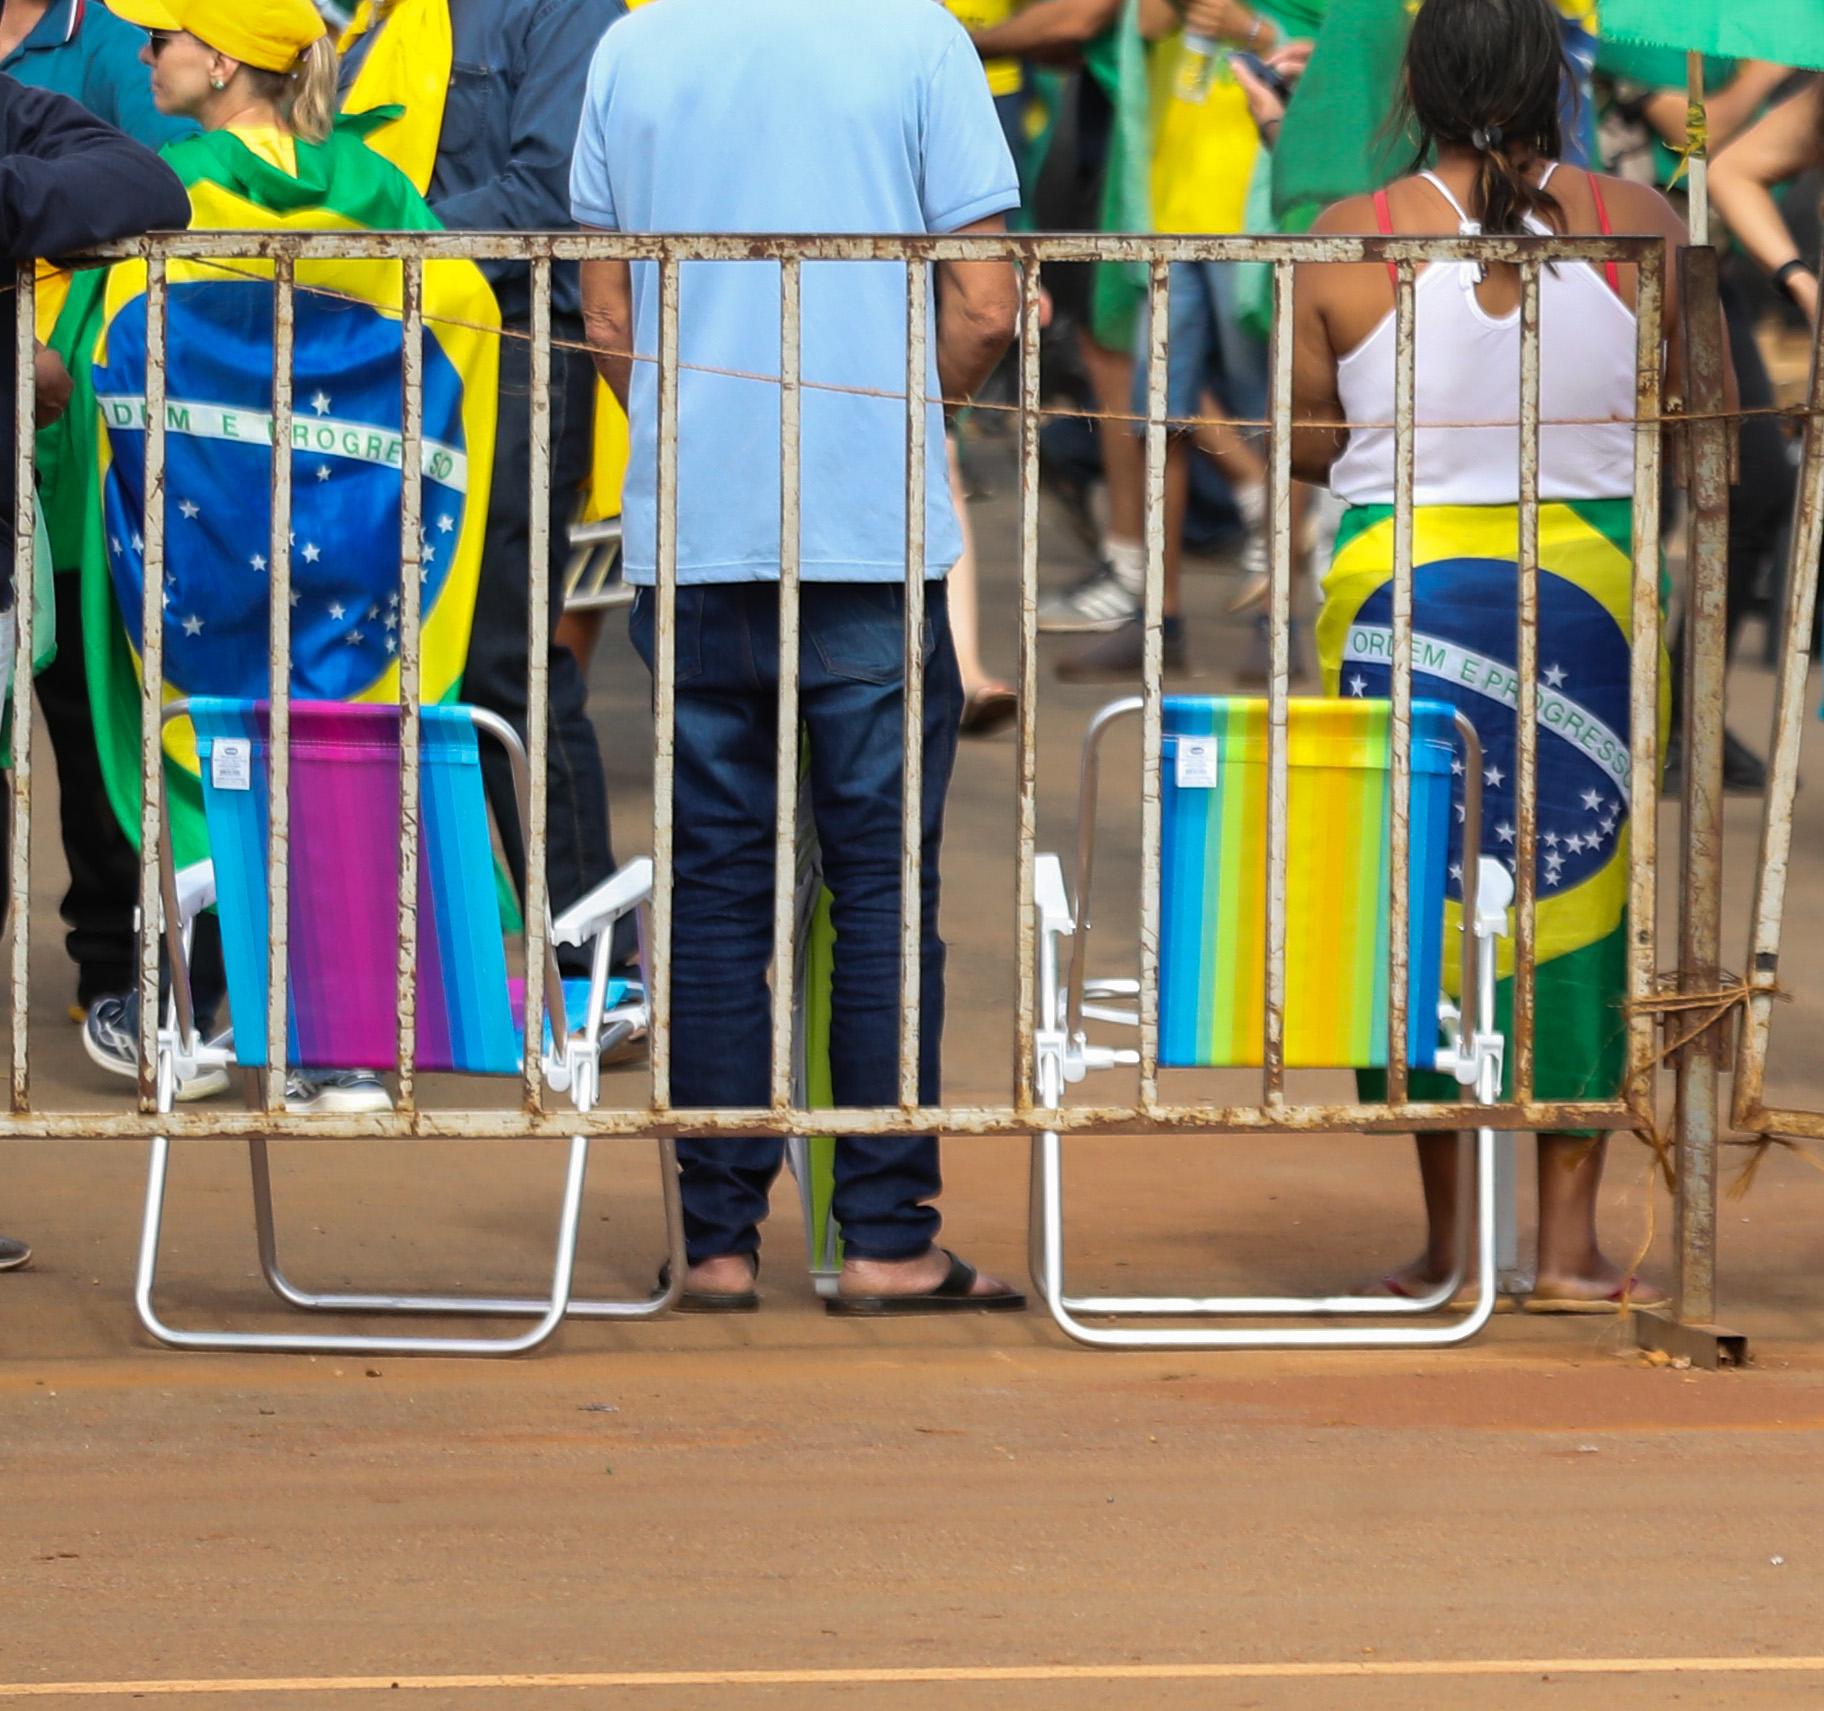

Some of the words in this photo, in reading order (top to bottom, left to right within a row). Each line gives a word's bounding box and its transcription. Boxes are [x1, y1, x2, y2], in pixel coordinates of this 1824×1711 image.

[222, 414, 240, 438] E
[267, 419, 454, 480] ROGRESO
[1460, 657, 1481, 684] E
